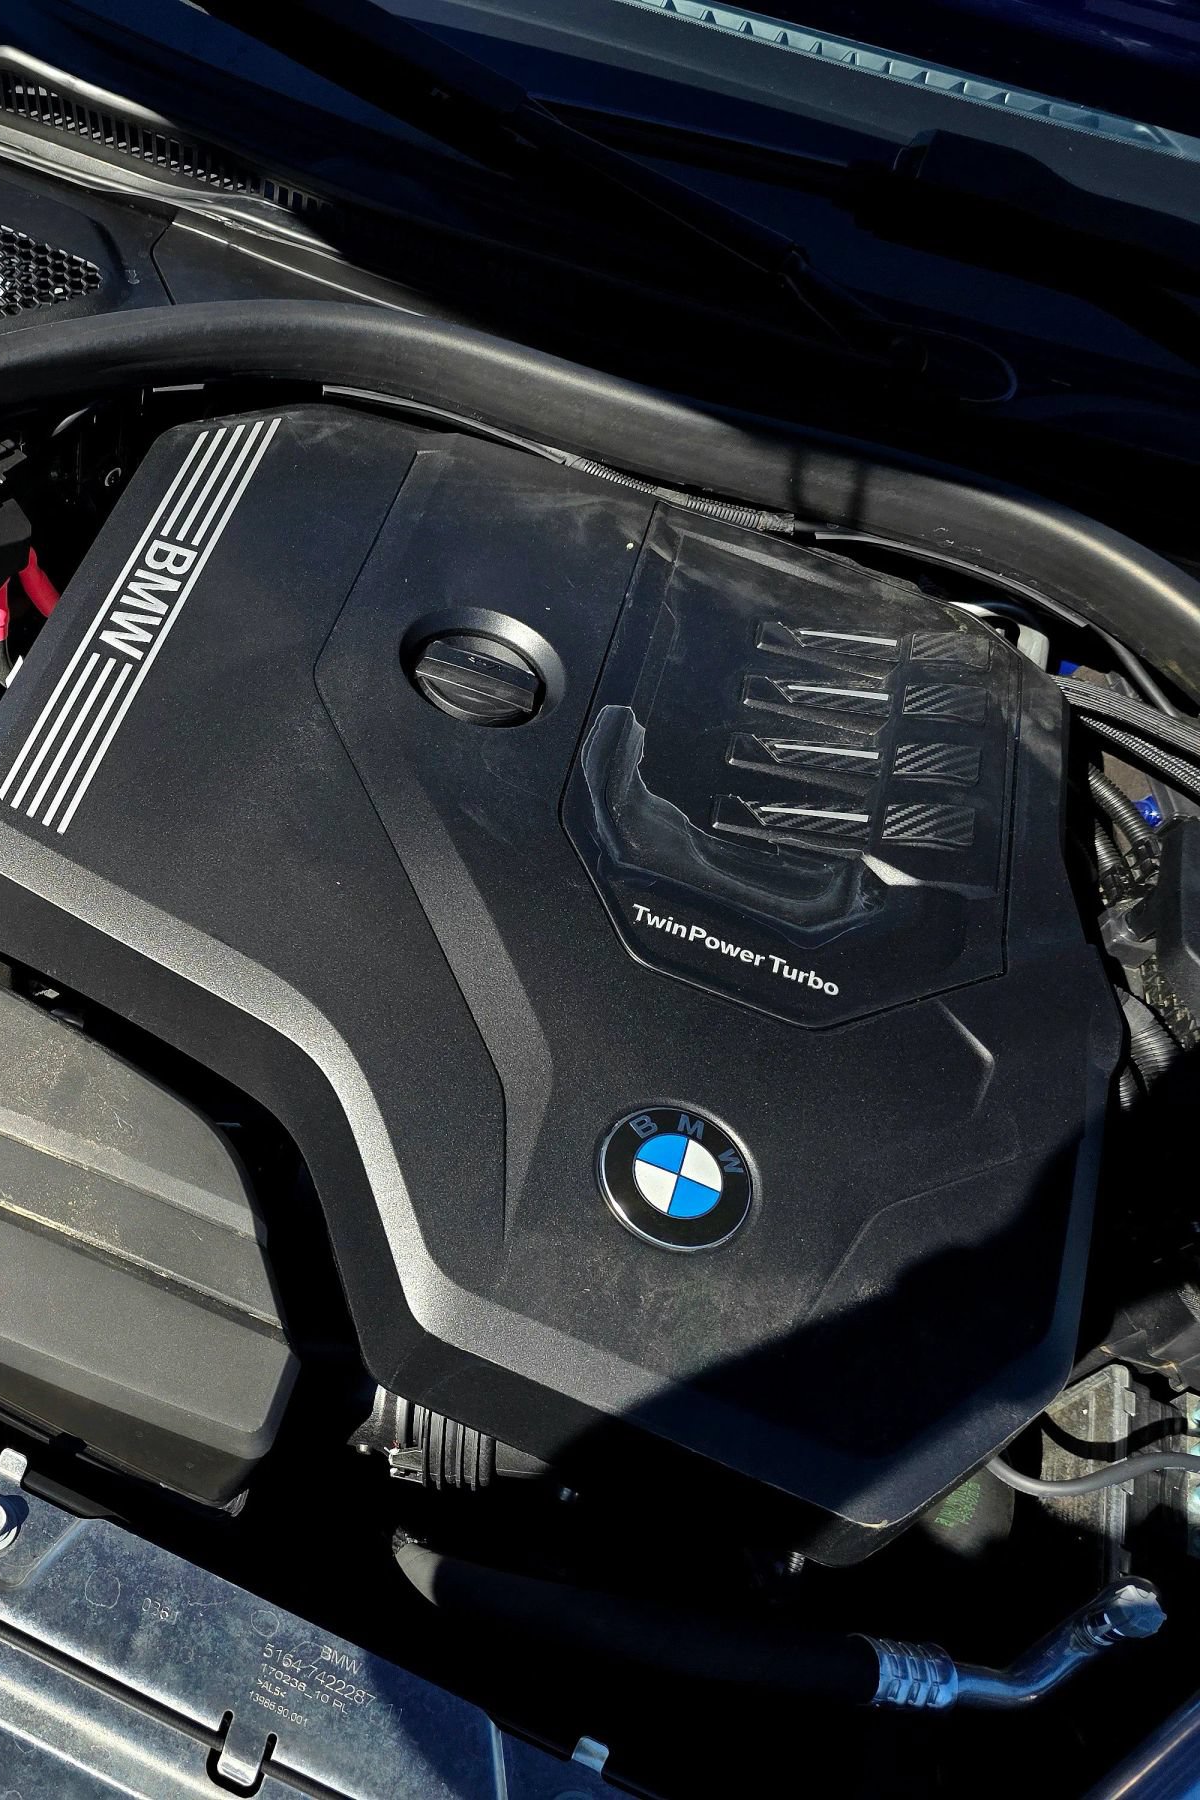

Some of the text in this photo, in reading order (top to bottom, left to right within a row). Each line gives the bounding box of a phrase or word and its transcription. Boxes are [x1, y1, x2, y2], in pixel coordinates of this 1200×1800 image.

[99, 540, 198, 661] BMW
[633, 904, 839, 996] TwinPower Turbo
[628, 1114, 744, 1174] BMW
[263, 1643, 301, 1673] 5164
[308, 1665, 377, 1708] 7422287
[320, 1645, 362, 1674] BMW
